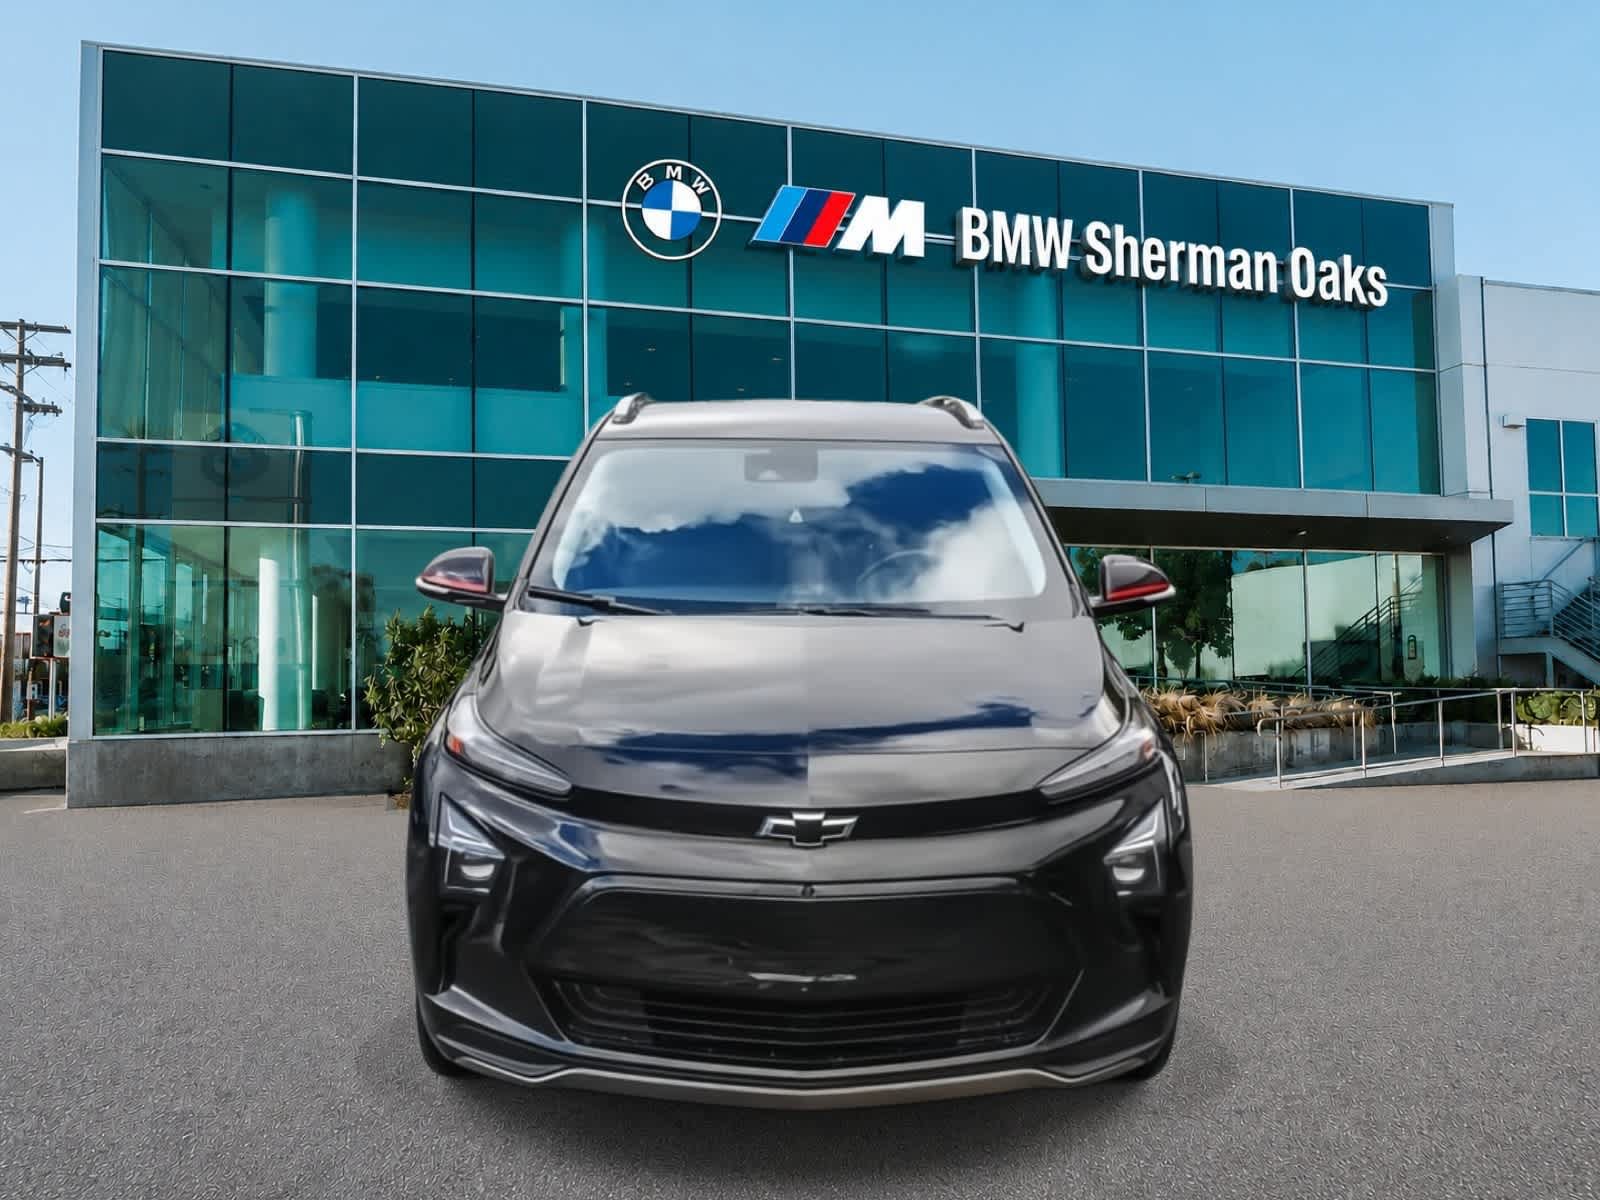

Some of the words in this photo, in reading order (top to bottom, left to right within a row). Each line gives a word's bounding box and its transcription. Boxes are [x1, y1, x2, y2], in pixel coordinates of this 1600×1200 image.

[636, 165, 710, 195] BMW
[838, 195, 925, 258] M
[960, 206, 1073, 270] BMW
[1084, 221, 1279, 293] Sherman
[1290, 247, 1389, 307] Oaks
